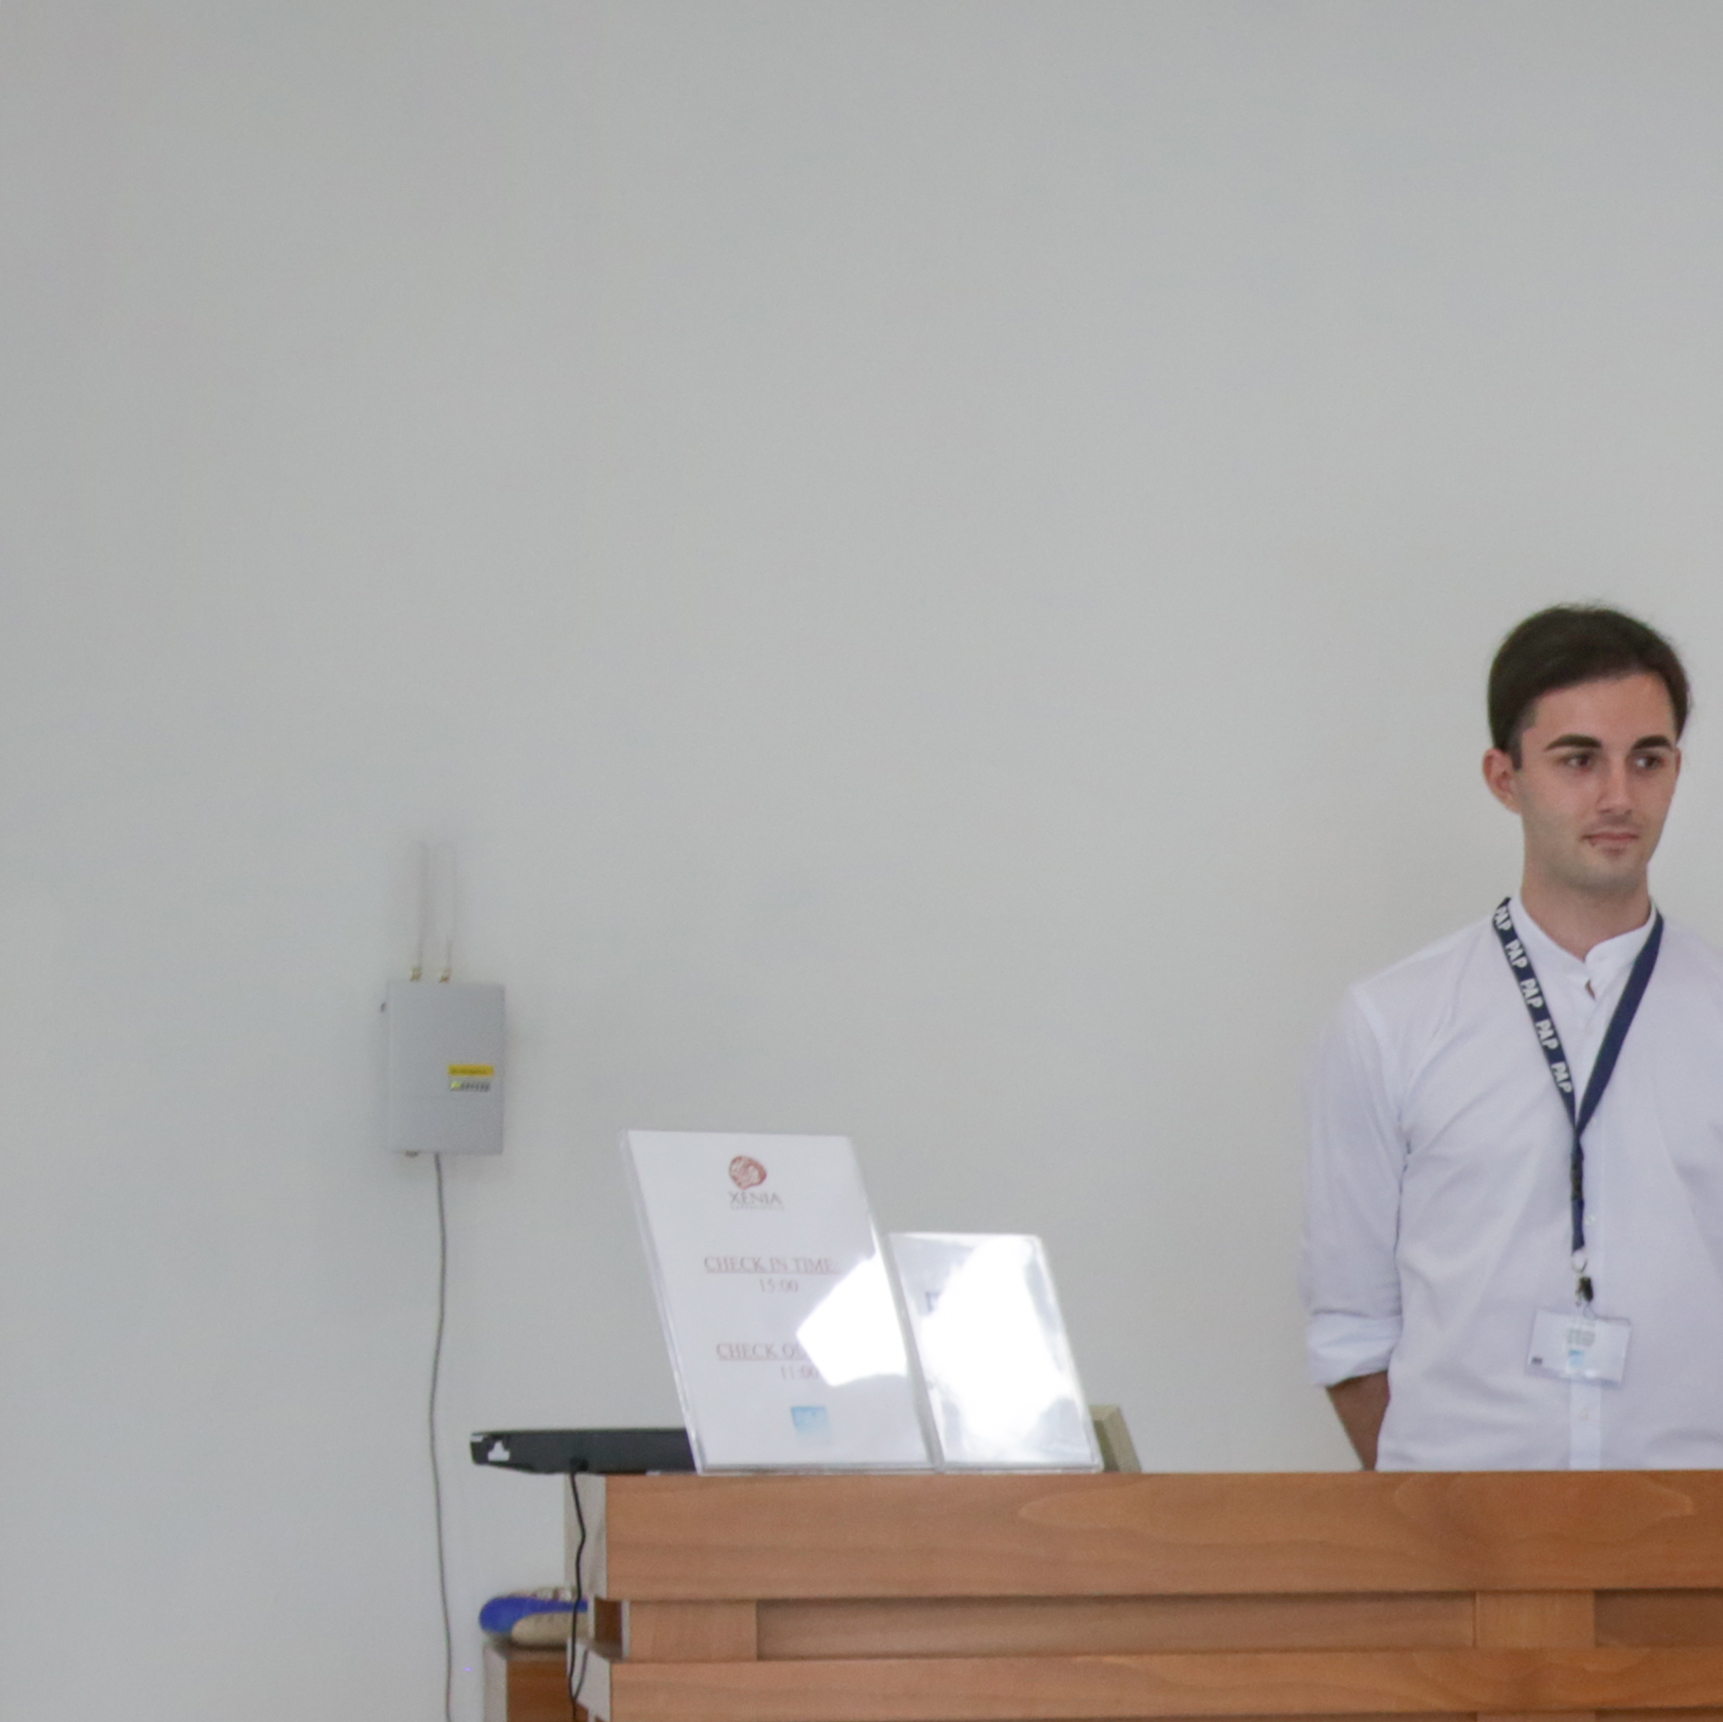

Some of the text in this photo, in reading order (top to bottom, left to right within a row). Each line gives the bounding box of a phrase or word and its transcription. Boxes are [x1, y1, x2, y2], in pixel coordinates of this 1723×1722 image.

[1505, 939, 1529, 968] PAP
[1520, 979, 1544, 1008] PAP
[1535, 1019, 1559, 1050] PAP
[1550, 1062, 1573, 1093] PAP
[730, 1192, 783, 1205] XENIA
[704, 1256, 766, 1273] CHECK
[769, 1257, 789, 1273] IN
[760, 1279, 799, 1292] 15:00
[717, 1343, 777, 1359] CHECK
